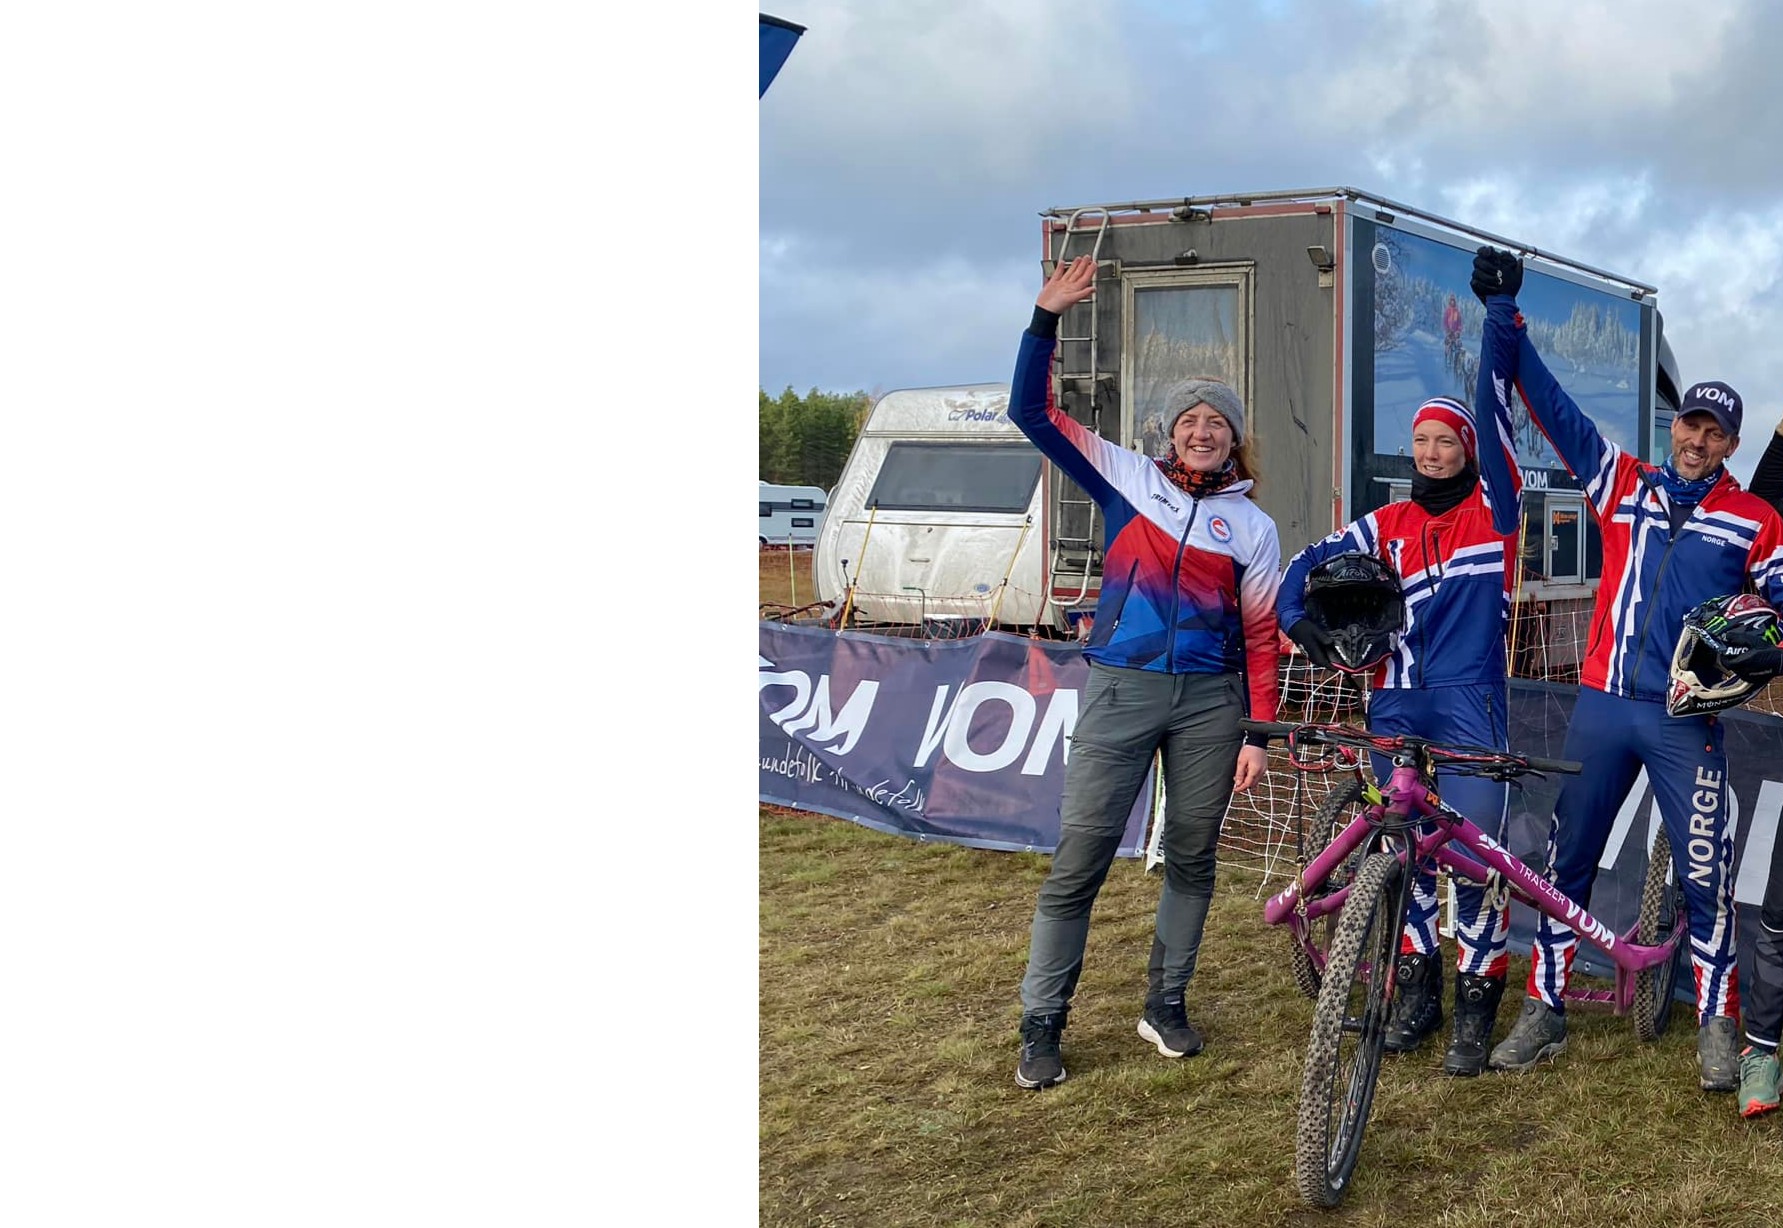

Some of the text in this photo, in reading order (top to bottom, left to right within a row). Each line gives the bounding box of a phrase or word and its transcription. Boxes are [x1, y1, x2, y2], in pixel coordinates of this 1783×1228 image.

[1696, 387, 1735, 412] VOM
[965, 408, 999, 421] Polar
[1520, 469, 1549, 489] VOM
[1701, 535, 1728, 547] NORGE
[1688, 766, 1722, 887] NORGE
[1519, 863, 1566, 906] TRACZER
